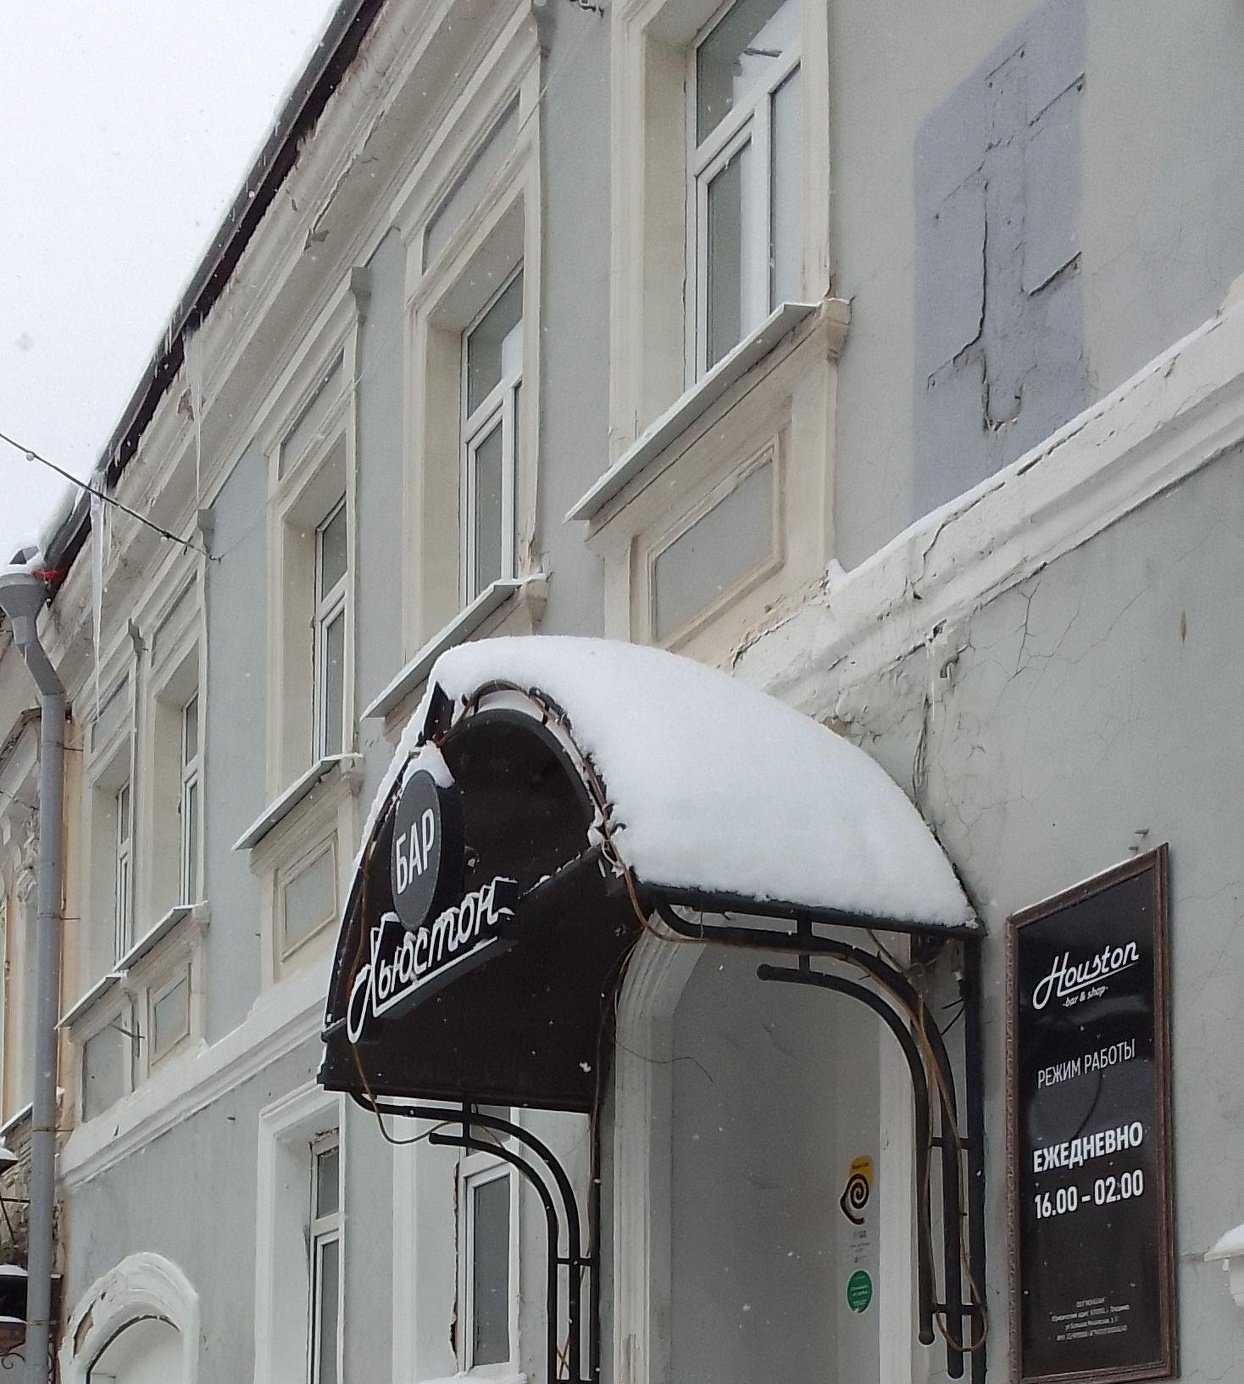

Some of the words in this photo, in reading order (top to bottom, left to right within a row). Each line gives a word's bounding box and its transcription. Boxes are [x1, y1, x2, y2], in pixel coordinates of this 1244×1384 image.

[396, 808, 435, 895] БАР
[347, 876, 500, 1043] Хьюстон
[1032, 941, 1140, 1010] Houston
[1037, 1057, 1081, 1088] РЕЖИМ
[1084, 1038, 1136, 1074] РАБОТЫ
[1033, 1121, 1143, 1173] ЕЖЕДНЕВНО
[1034, 1186, 1078, 1219] 16.00
[1094, 1169, 1144, 1206] 02.00
